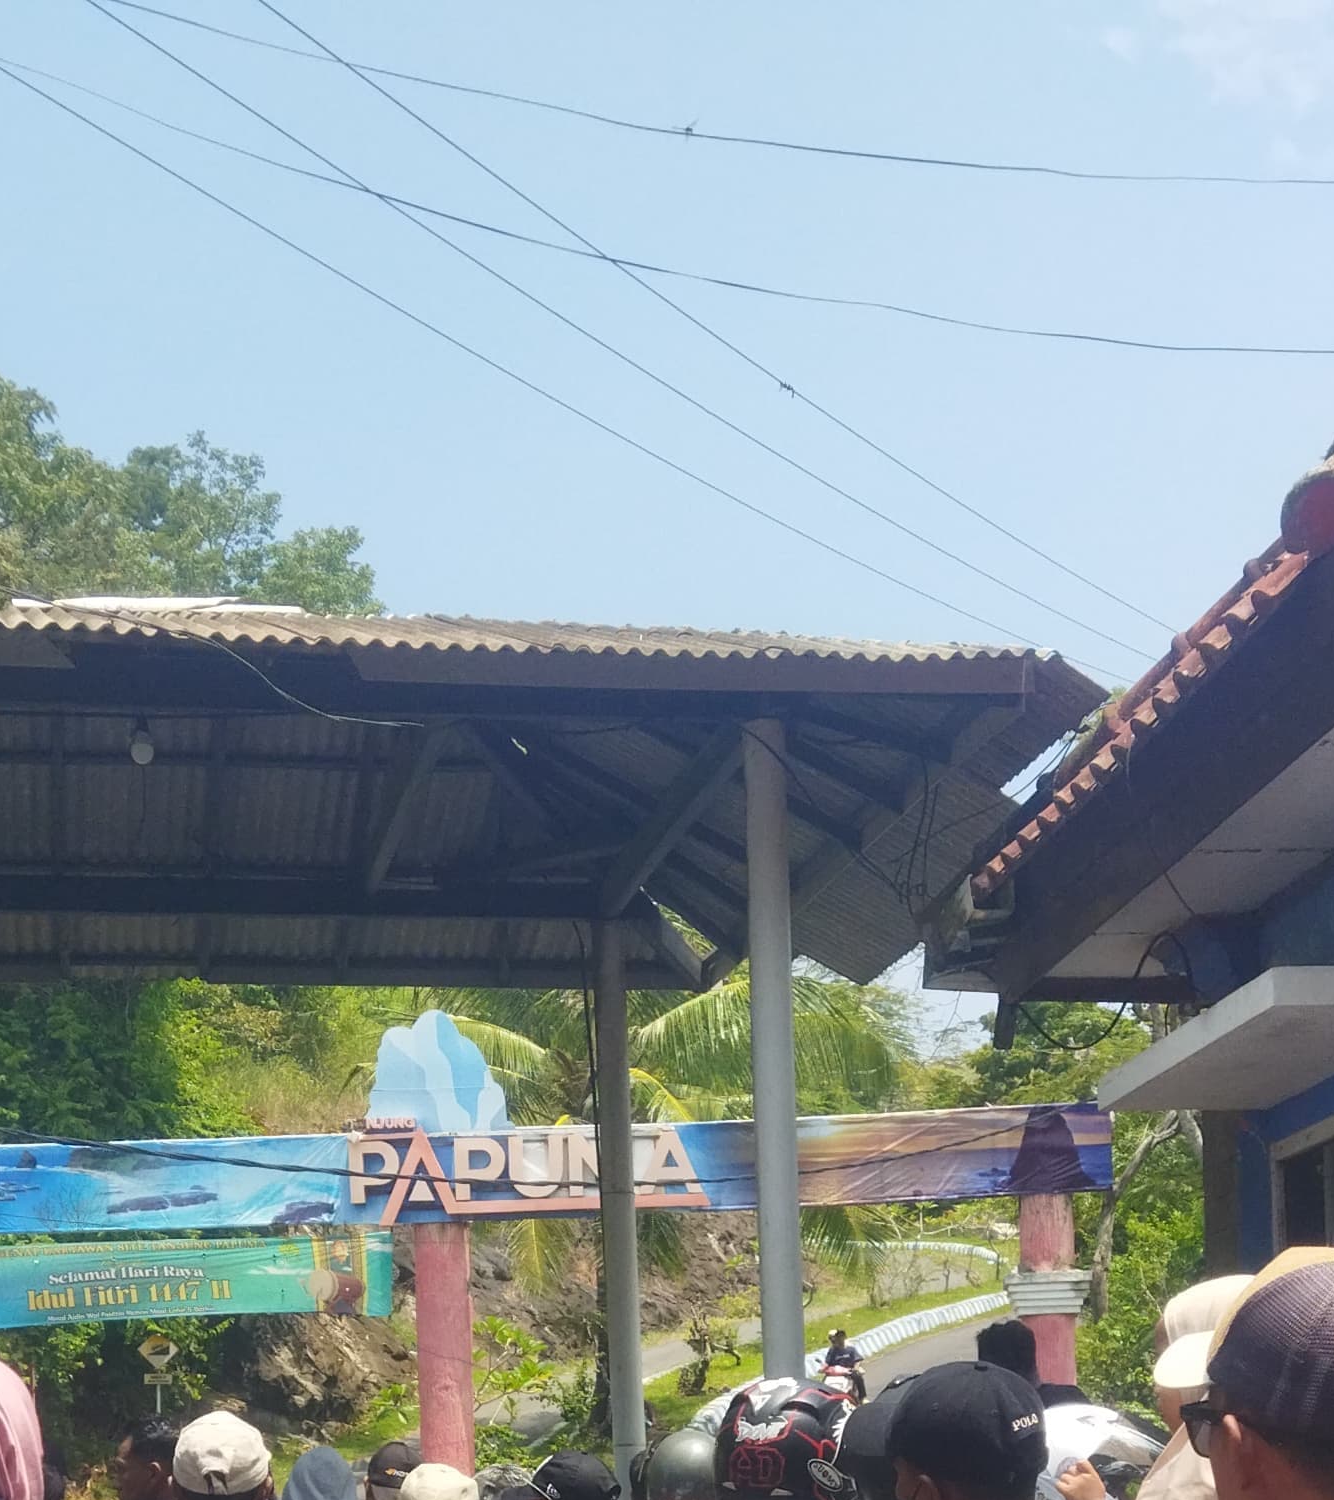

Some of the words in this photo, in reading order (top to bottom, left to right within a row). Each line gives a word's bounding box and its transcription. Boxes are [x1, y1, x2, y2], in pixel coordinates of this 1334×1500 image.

[49, 1268, 117, 1285] Selamat
[121, 1266, 159, 1279] Hari
[163, 1265, 205, 1280] Raya
[27, 1287, 76, 1311] Idul
[83, 1284, 138, 1306] Fitri
[210, 1279, 231, 1299] H
[1012, 1413, 1038, 1432] POLO
